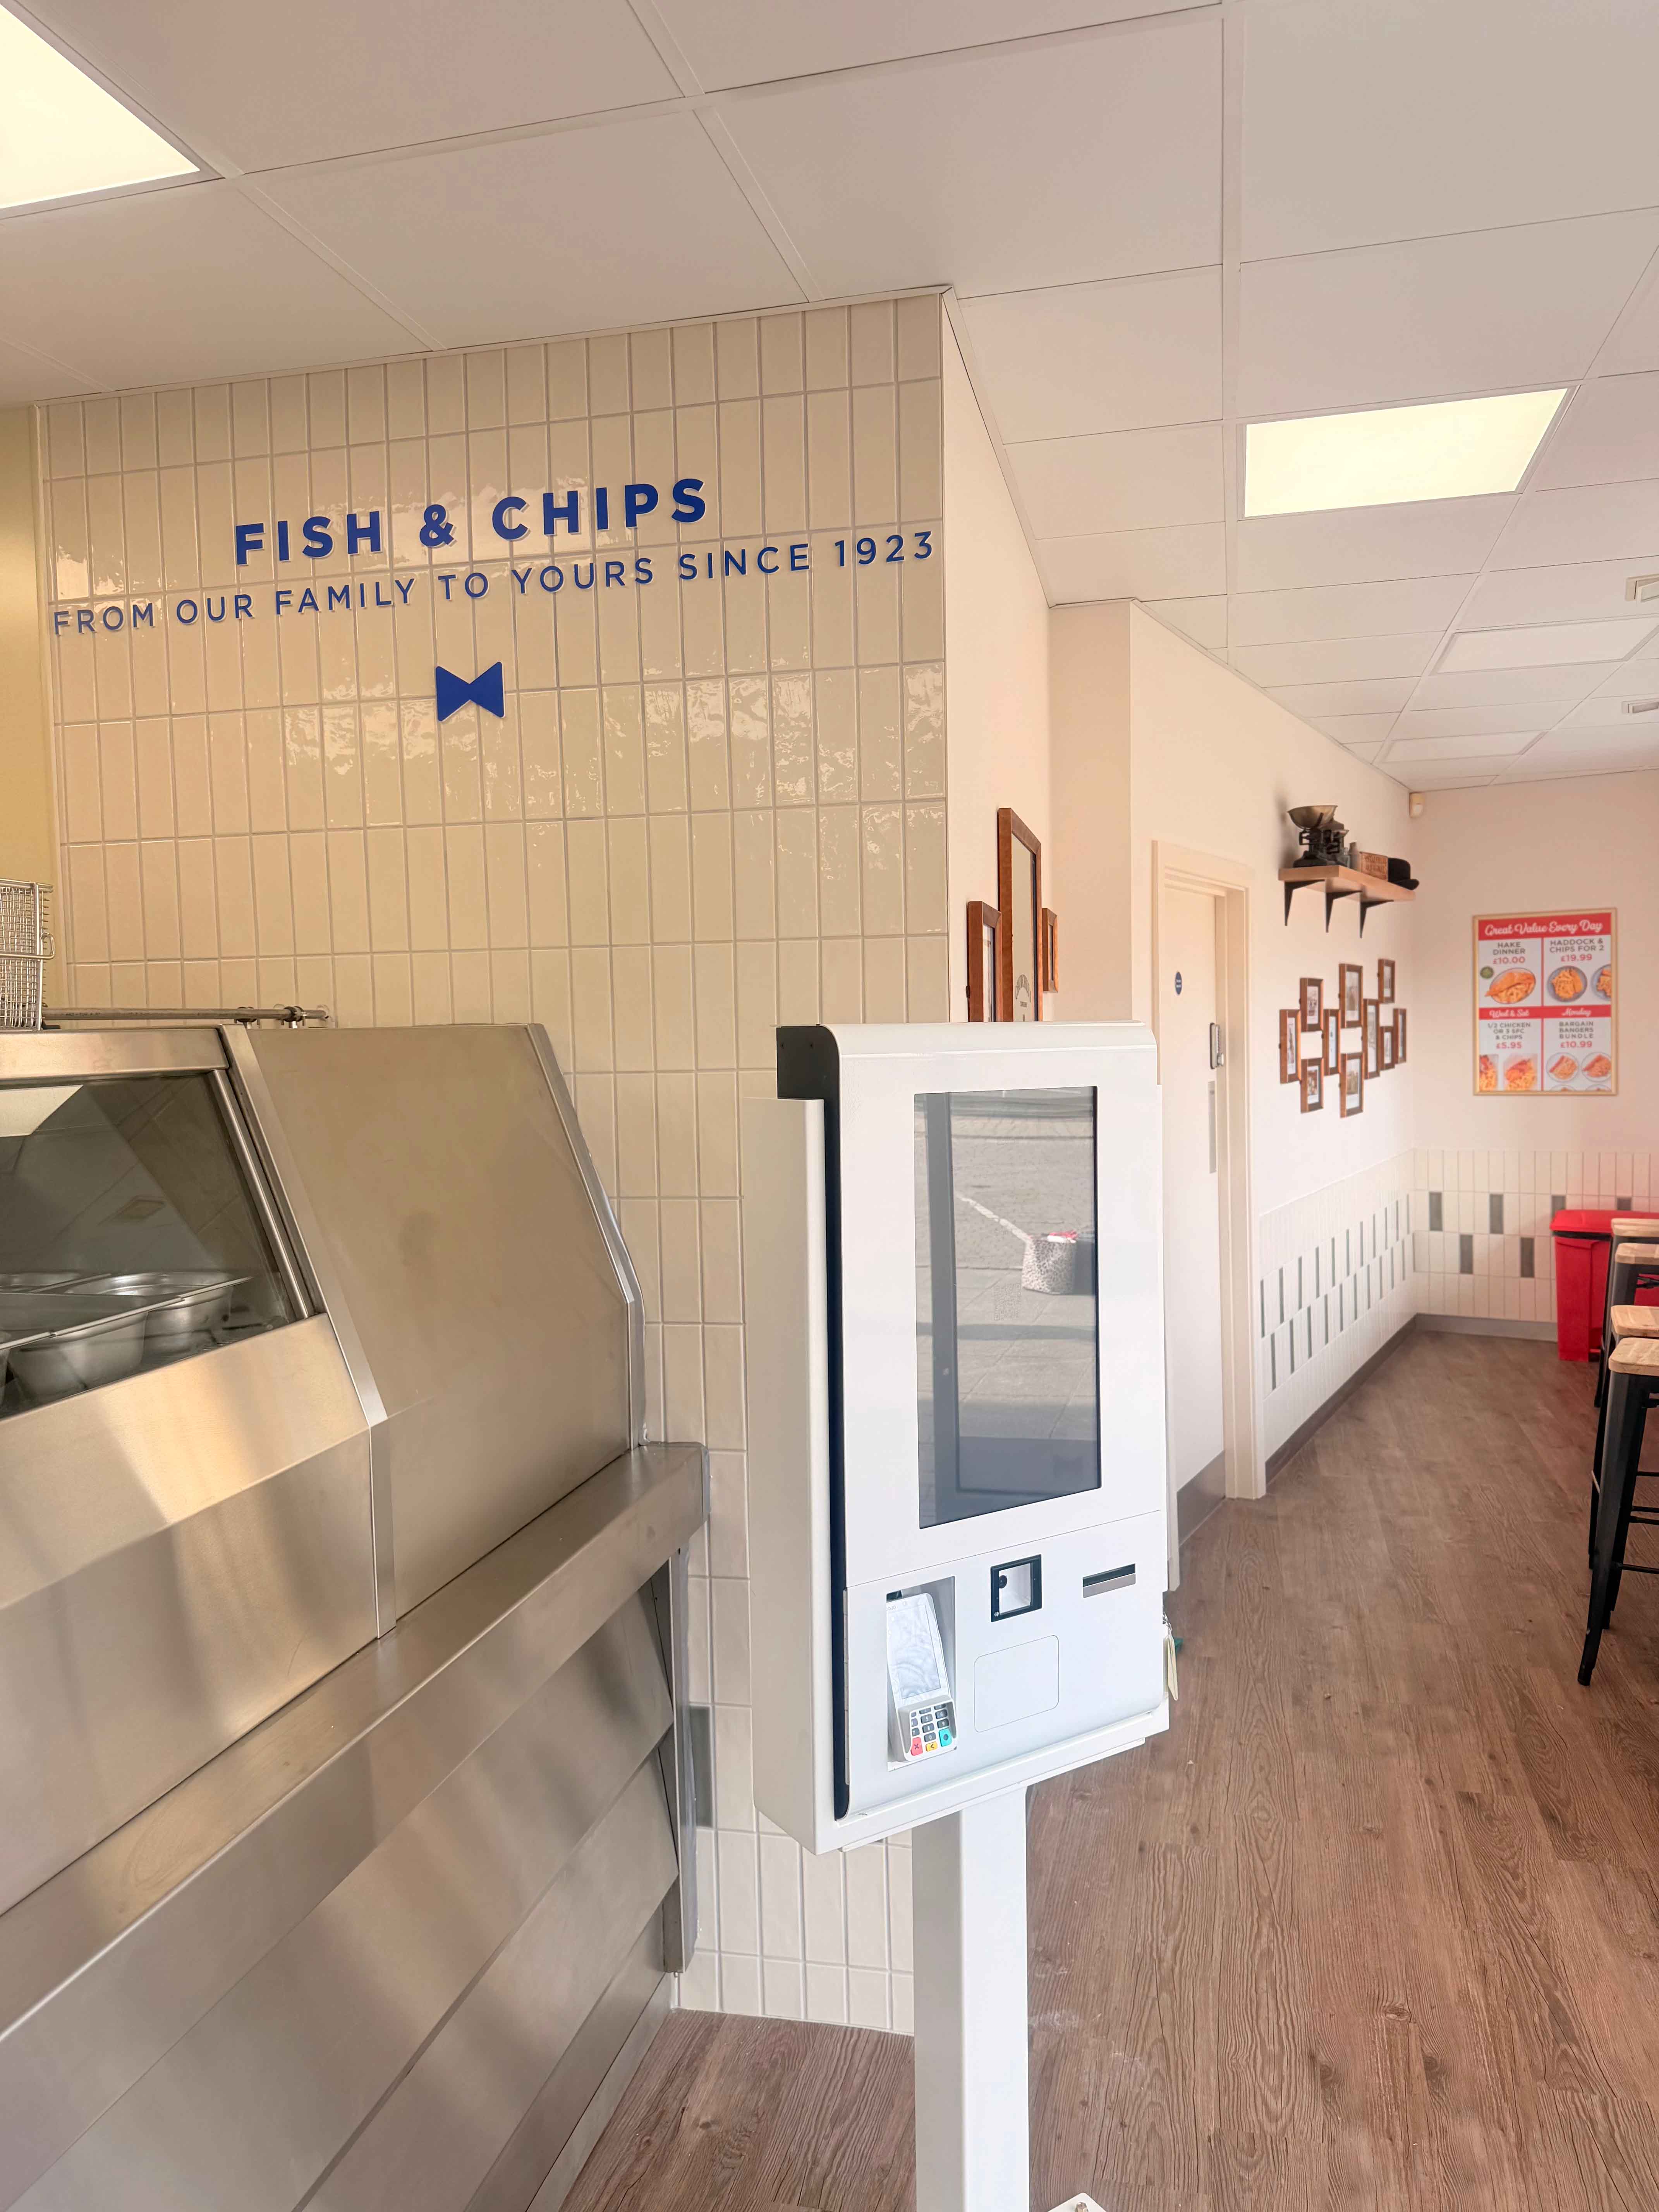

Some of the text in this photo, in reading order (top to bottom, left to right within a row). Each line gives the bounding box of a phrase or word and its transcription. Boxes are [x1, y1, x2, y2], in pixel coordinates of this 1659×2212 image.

[235, 479, 706, 565] FISH & CHIPS
[54, 531, 933, 635] FROM OUR FAMILY TO YOURS SINCE 1923
[1485, 920, 1603, 936] Great Value Every Day
[1493, 956, 1526, 964] £10.00
[1561, 954, 1593, 962] £19.99
[1561, 1007, 1591, 1017] Monday
